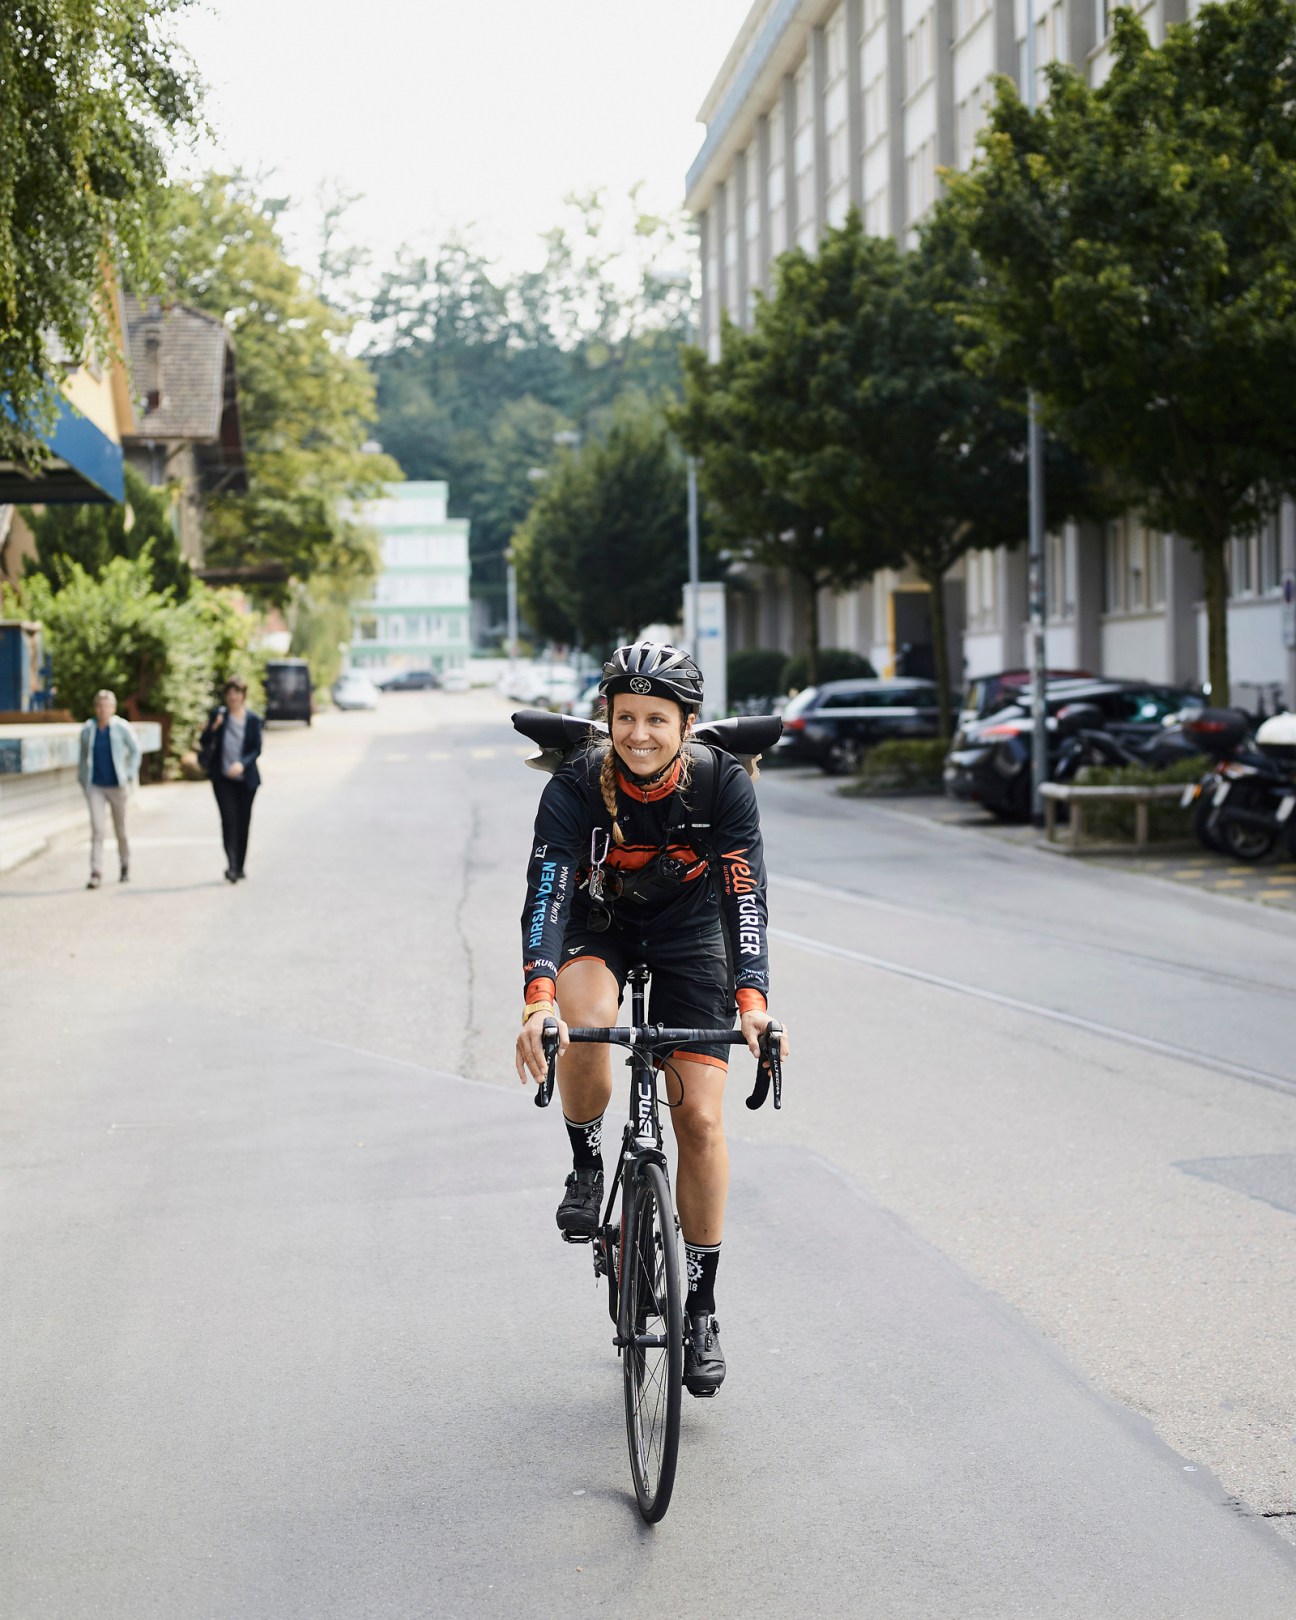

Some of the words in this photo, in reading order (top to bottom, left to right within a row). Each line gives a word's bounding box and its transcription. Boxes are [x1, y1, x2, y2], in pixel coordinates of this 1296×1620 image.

[529, 861, 557, 949] HIRSLANDEN
[559, 866, 569, 891] ANNA
[638, 1082, 653, 1137] BMC
